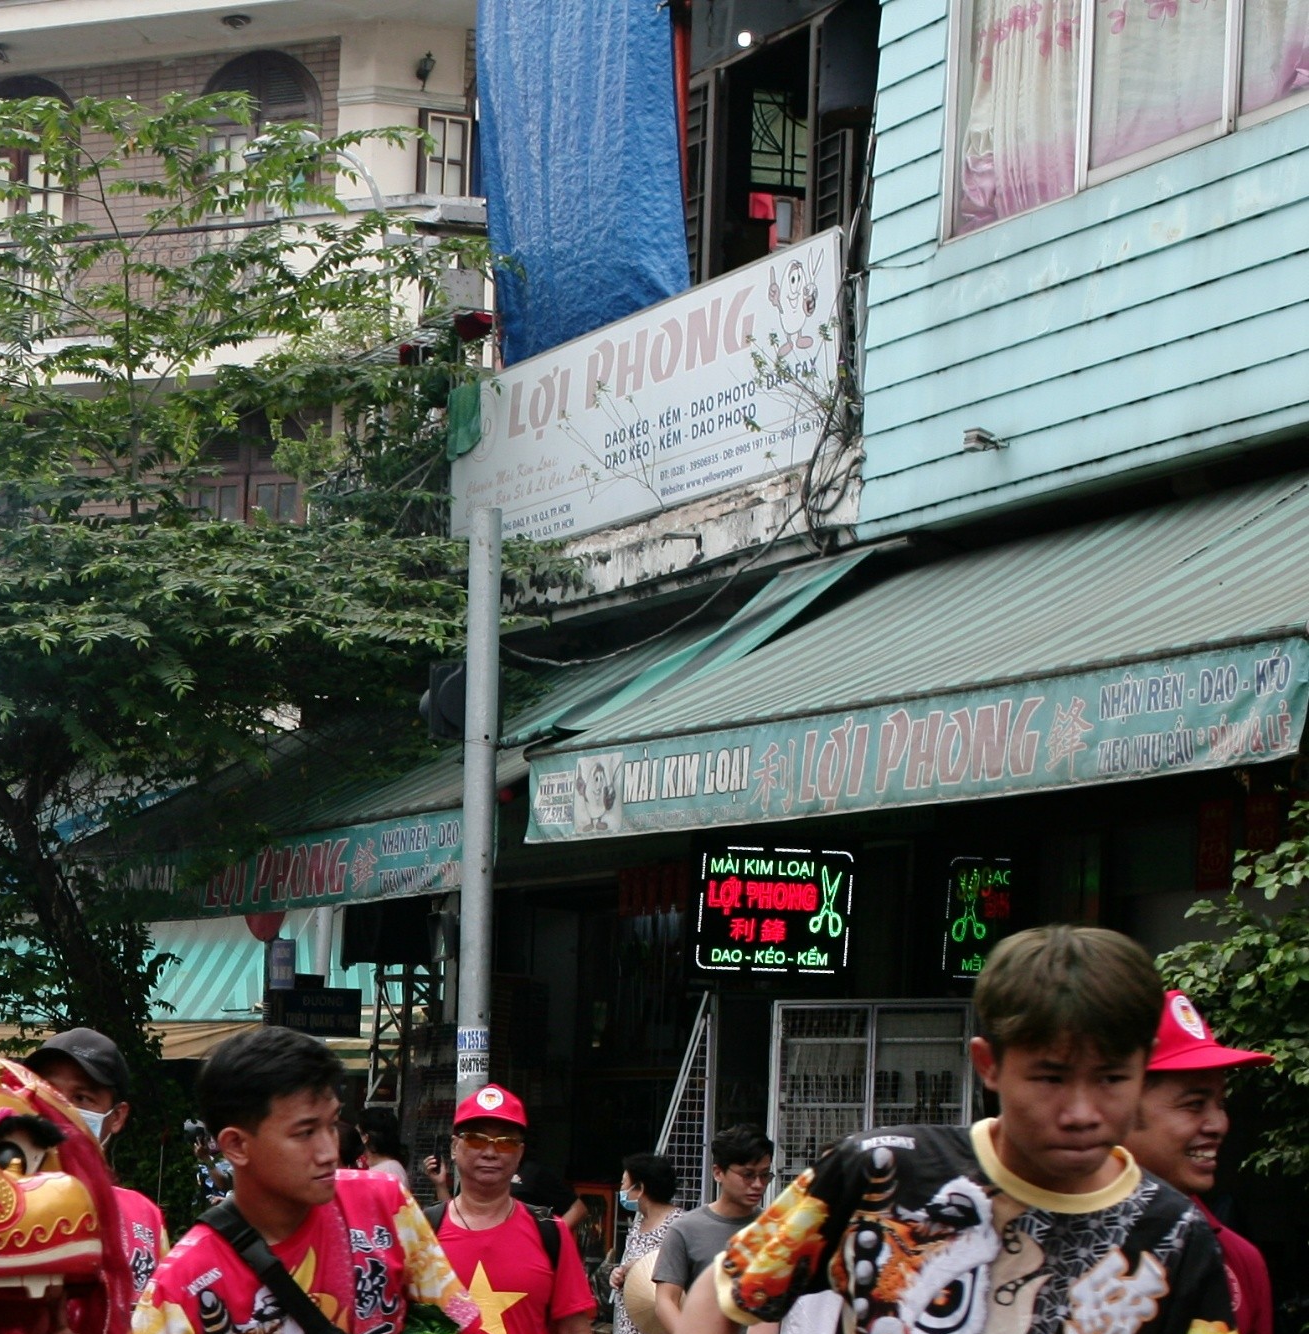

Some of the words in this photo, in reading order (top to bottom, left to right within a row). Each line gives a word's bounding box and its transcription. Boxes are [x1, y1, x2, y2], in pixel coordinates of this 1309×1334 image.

[508, 366, 571, 441] LỢI
[585, 286, 755, 410] PHONG
[604, 429, 627, 448] DAO
[629, 418, 649, 440] KÉO
[691, 396, 714, 418] DAO
[717, 380, 756, 408] PHOTO
[604, 449, 627, 470] DAO
[629, 439, 649, 461] KÉO
[691, 418, 715, 440] DAO
[718, 402, 757, 430] PHOTO
[1100, 672, 1144, 723] NHẬN
[1147, 666, 1185, 713] RÈN
[1199, 664, 1238, 706] DAO
[1255, 647, 1292, 698] KÉO
[799, 717, 869, 813] LỢI
[875, 696, 1045, 793] PHONG
[1098, 737, 1131, 775] THEO
[1133, 730, 1162, 769] NHU
[1166, 715, 1194, 766] CẦU
[1266, 699, 1292, 751] LẺ
[623, 747, 659, 804] MÀI
[662, 752, 700, 799] KIM
[704, 745, 751, 804] LOẠI
[751, 739, 796, 813] 利
[252, 838, 350, 904] PHONG
[381, 823, 408, 860] NHẬN
[409, 818, 430, 852] RÈN
[438, 820, 460, 849] DAO
[711, 853, 739, 874] MÀI
[744, 858, 773, 875] KIM
[778, 860, 814, 879] LOẠI
[708, 876, 742, 915] LỢI
[746, 881, 818, 911] PHONG
[711, 949, 742, 963] DAO
[755, 946, 785, 964] KÉO
